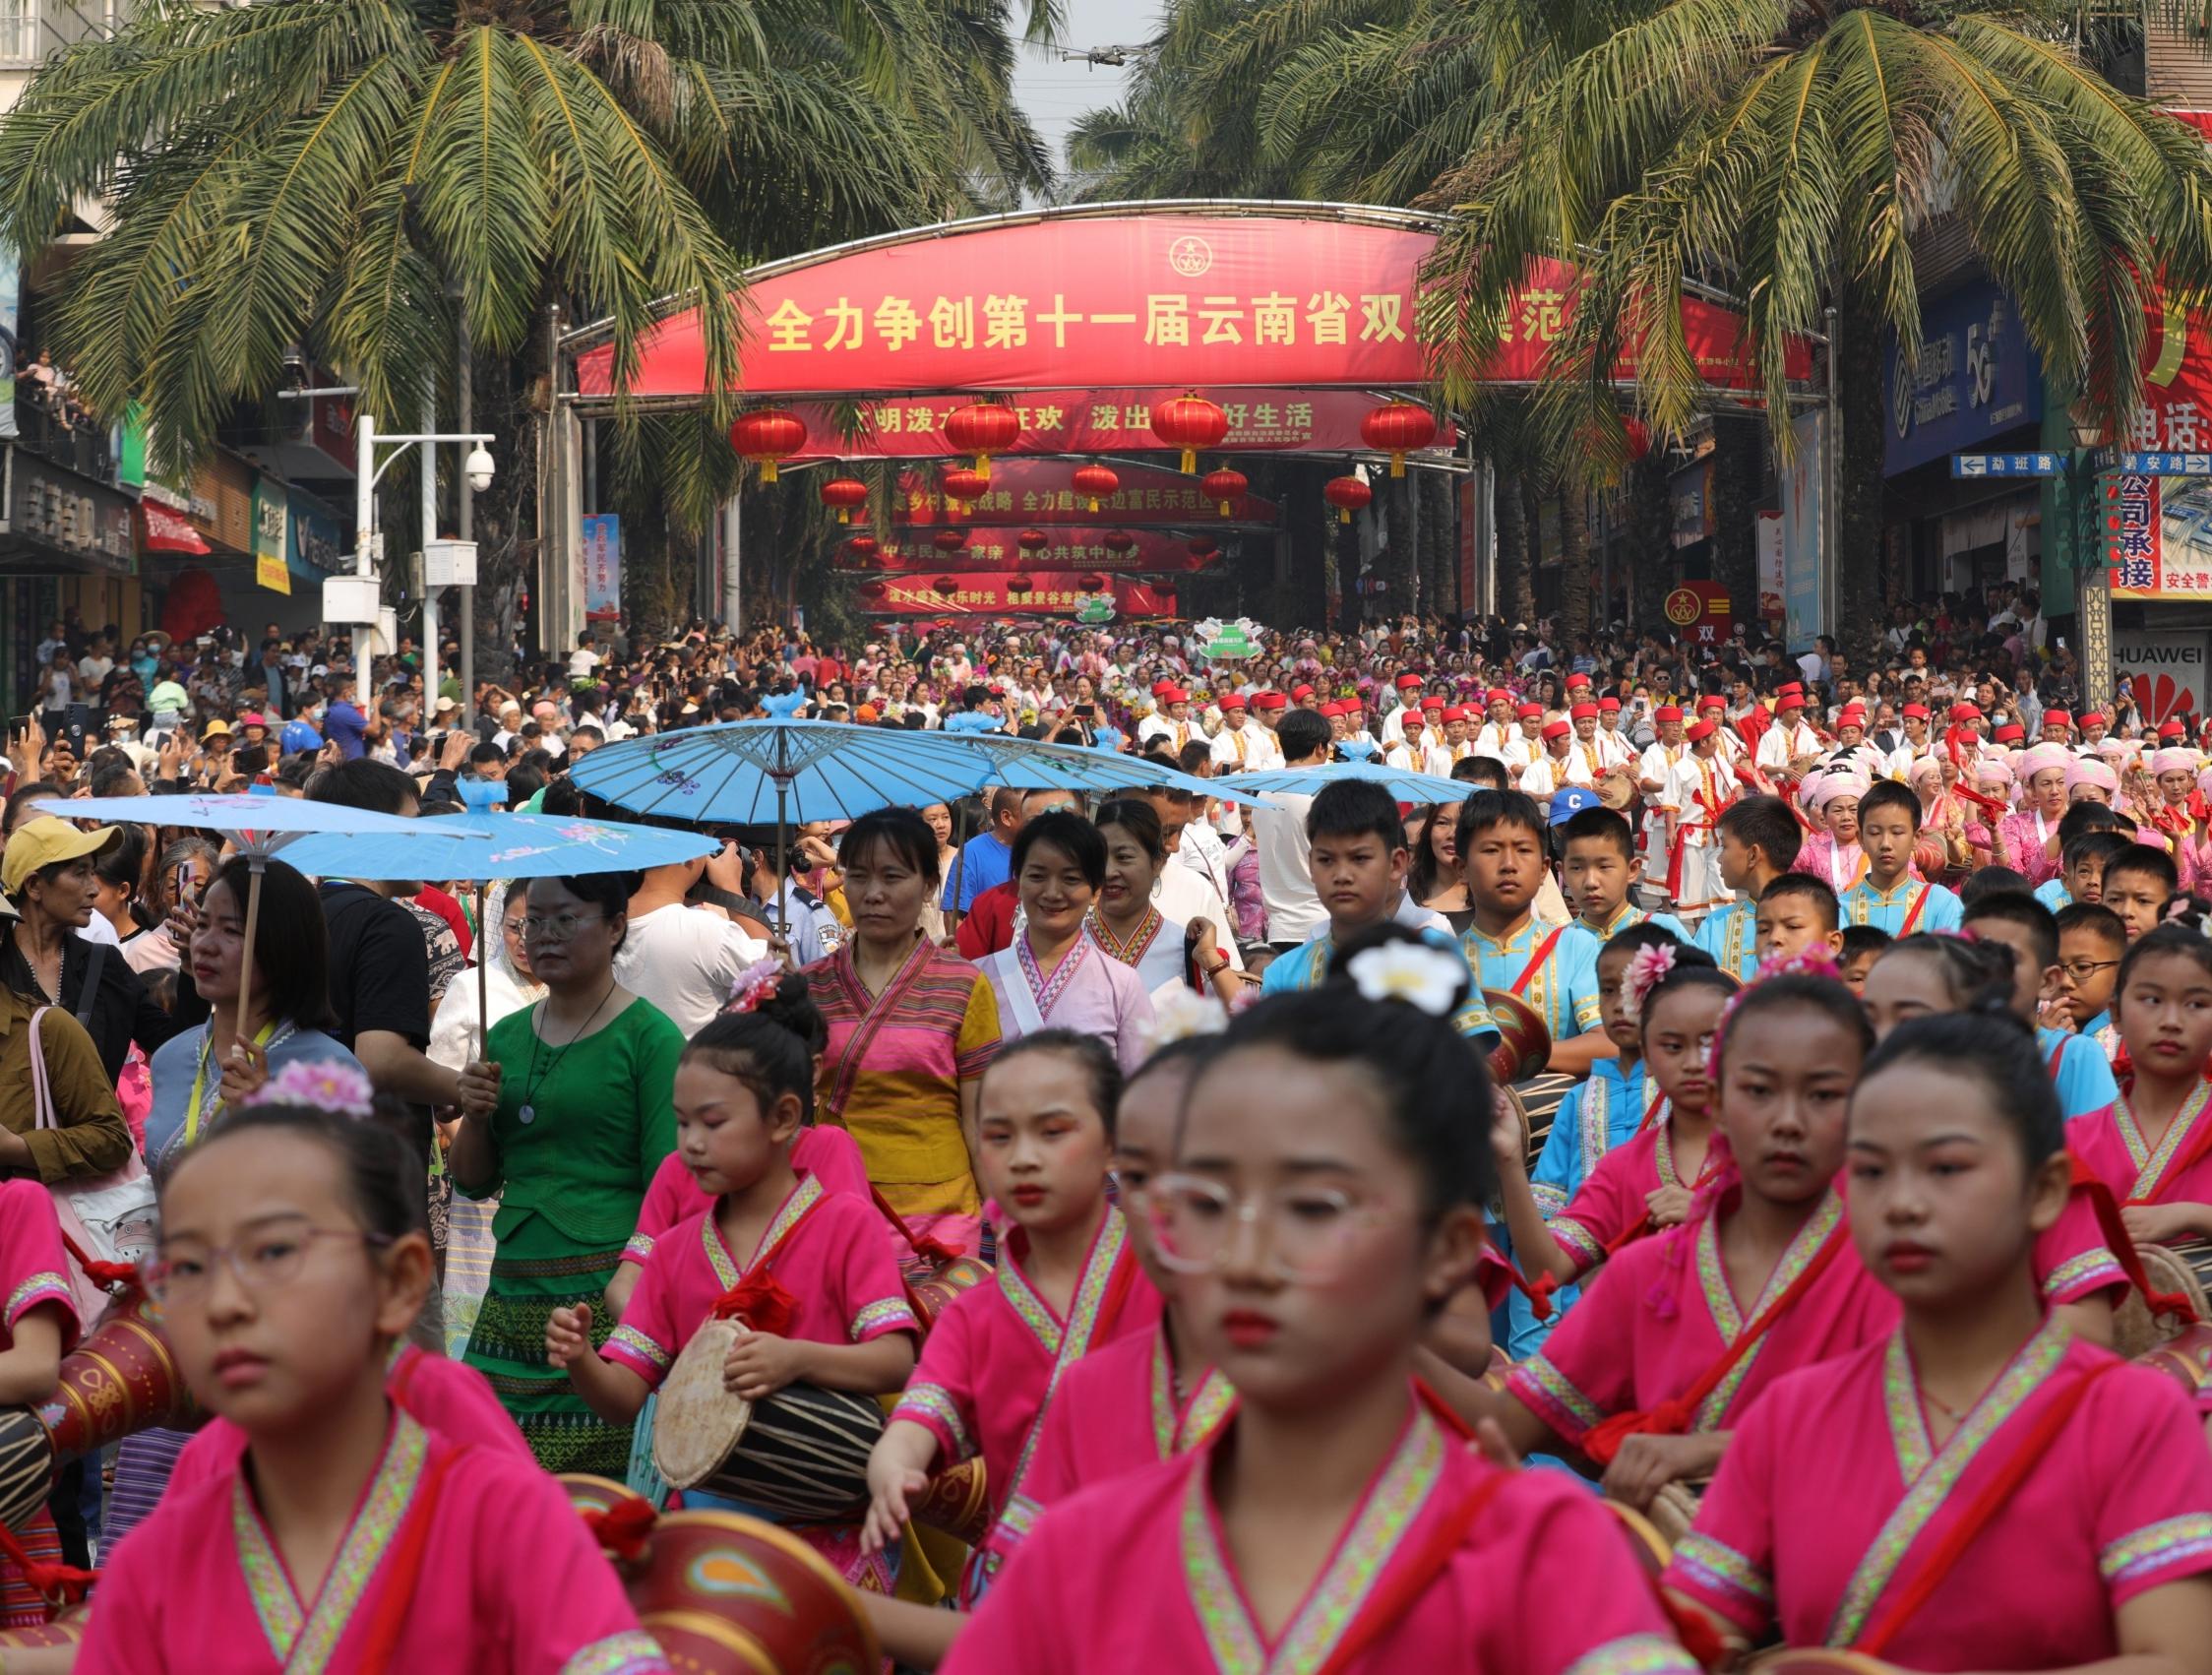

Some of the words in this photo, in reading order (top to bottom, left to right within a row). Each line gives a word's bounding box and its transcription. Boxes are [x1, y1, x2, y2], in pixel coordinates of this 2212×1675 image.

[767, 288, 1604, 351] 全力争创第十一届云南省双范
[1091, 403, 1314, 431] 泼出好生活
[1992, 455, 2052, 471] 勐班路
[2124, 455, 2183, 471] 碧安路
[2167, 572, 2212, 589] 安全警
[2114, 647, 2202, 663] HUAWEI
[1568, 794, 1582, 809] C
